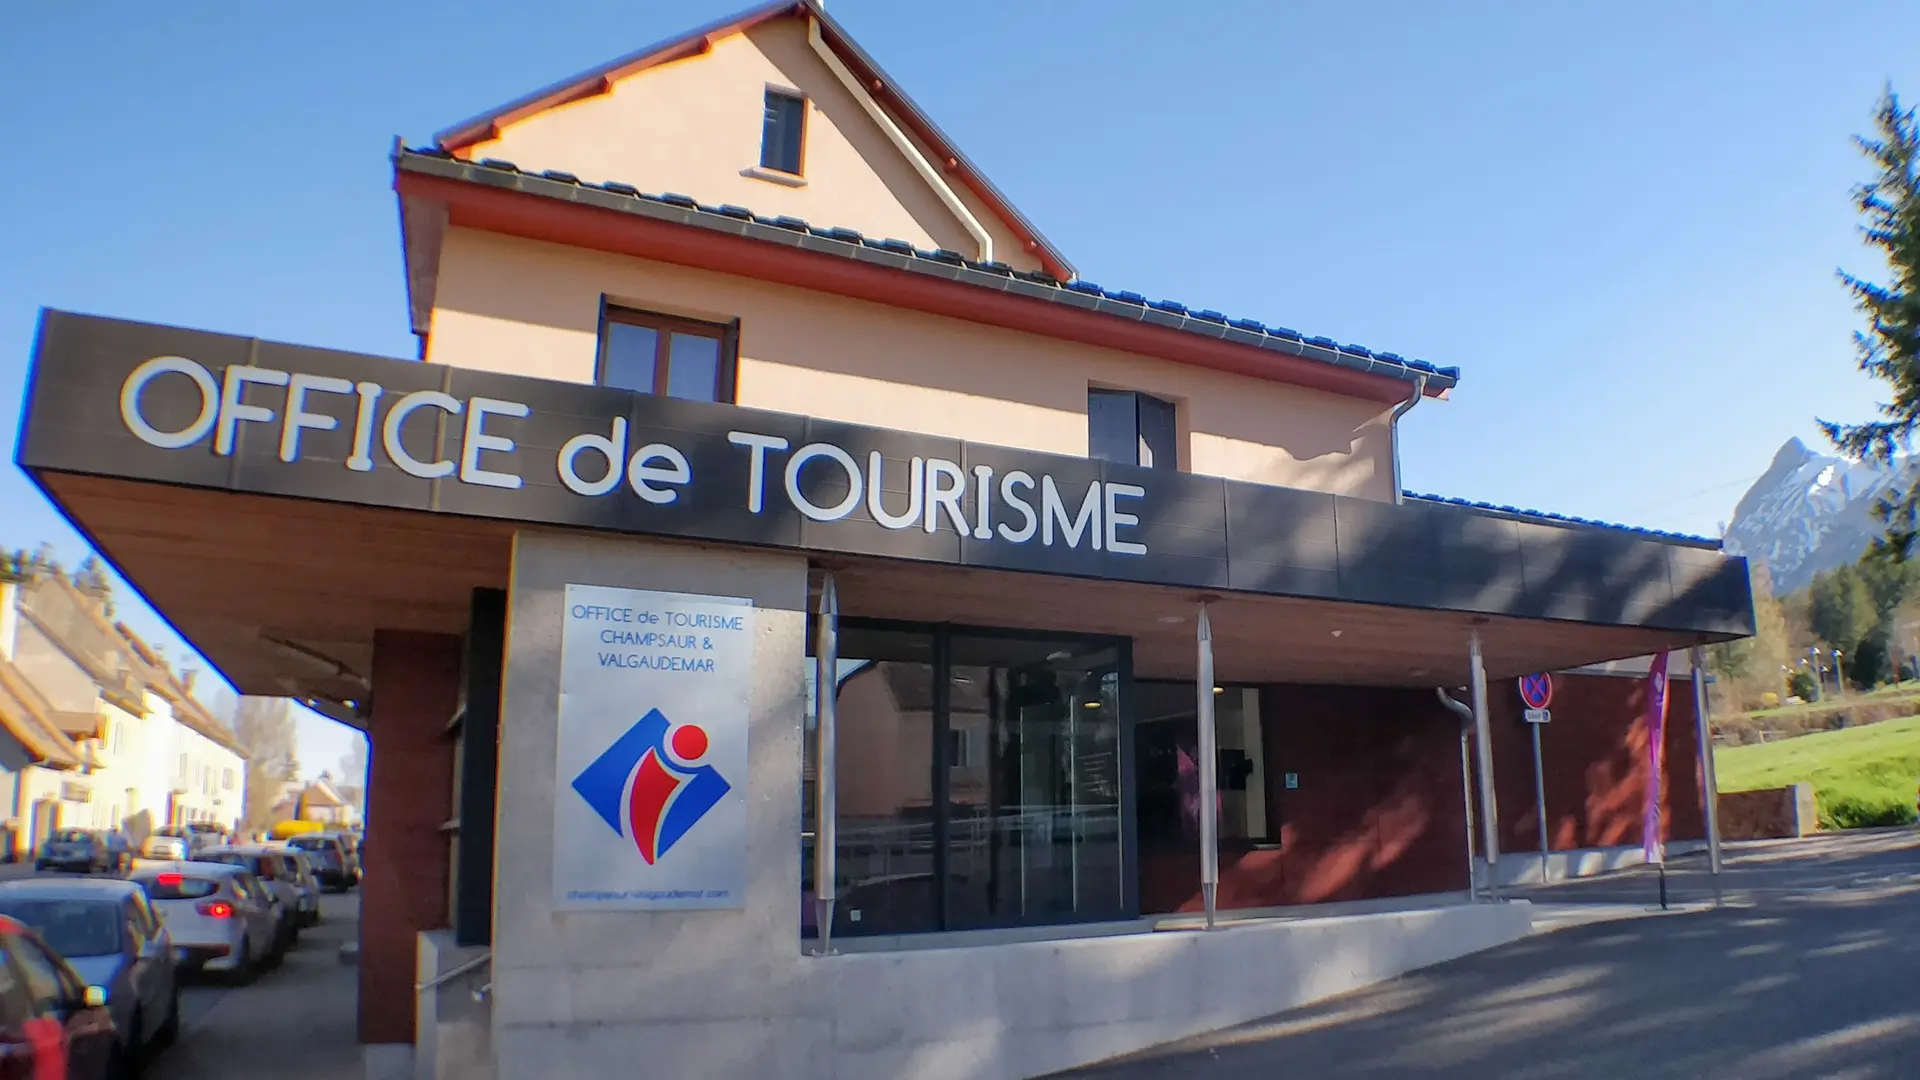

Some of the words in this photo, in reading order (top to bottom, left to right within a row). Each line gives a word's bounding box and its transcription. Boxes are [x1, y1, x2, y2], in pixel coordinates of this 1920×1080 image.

[119, 356, 530, 489] OFFICE
[557, 416, 691, 505] de
[727, 431, 1148, 555] TOURISME
[571, 604, 633, 622] OFFICE
[638, 611, 659, 625] de
[665, 612, 743, 630] TOURISME
[600, 630, 697, 648] CHAMPSAUR
[703, 637, 714, 650] &
[598, 652, 714, 672] VALGAUDEMAR
